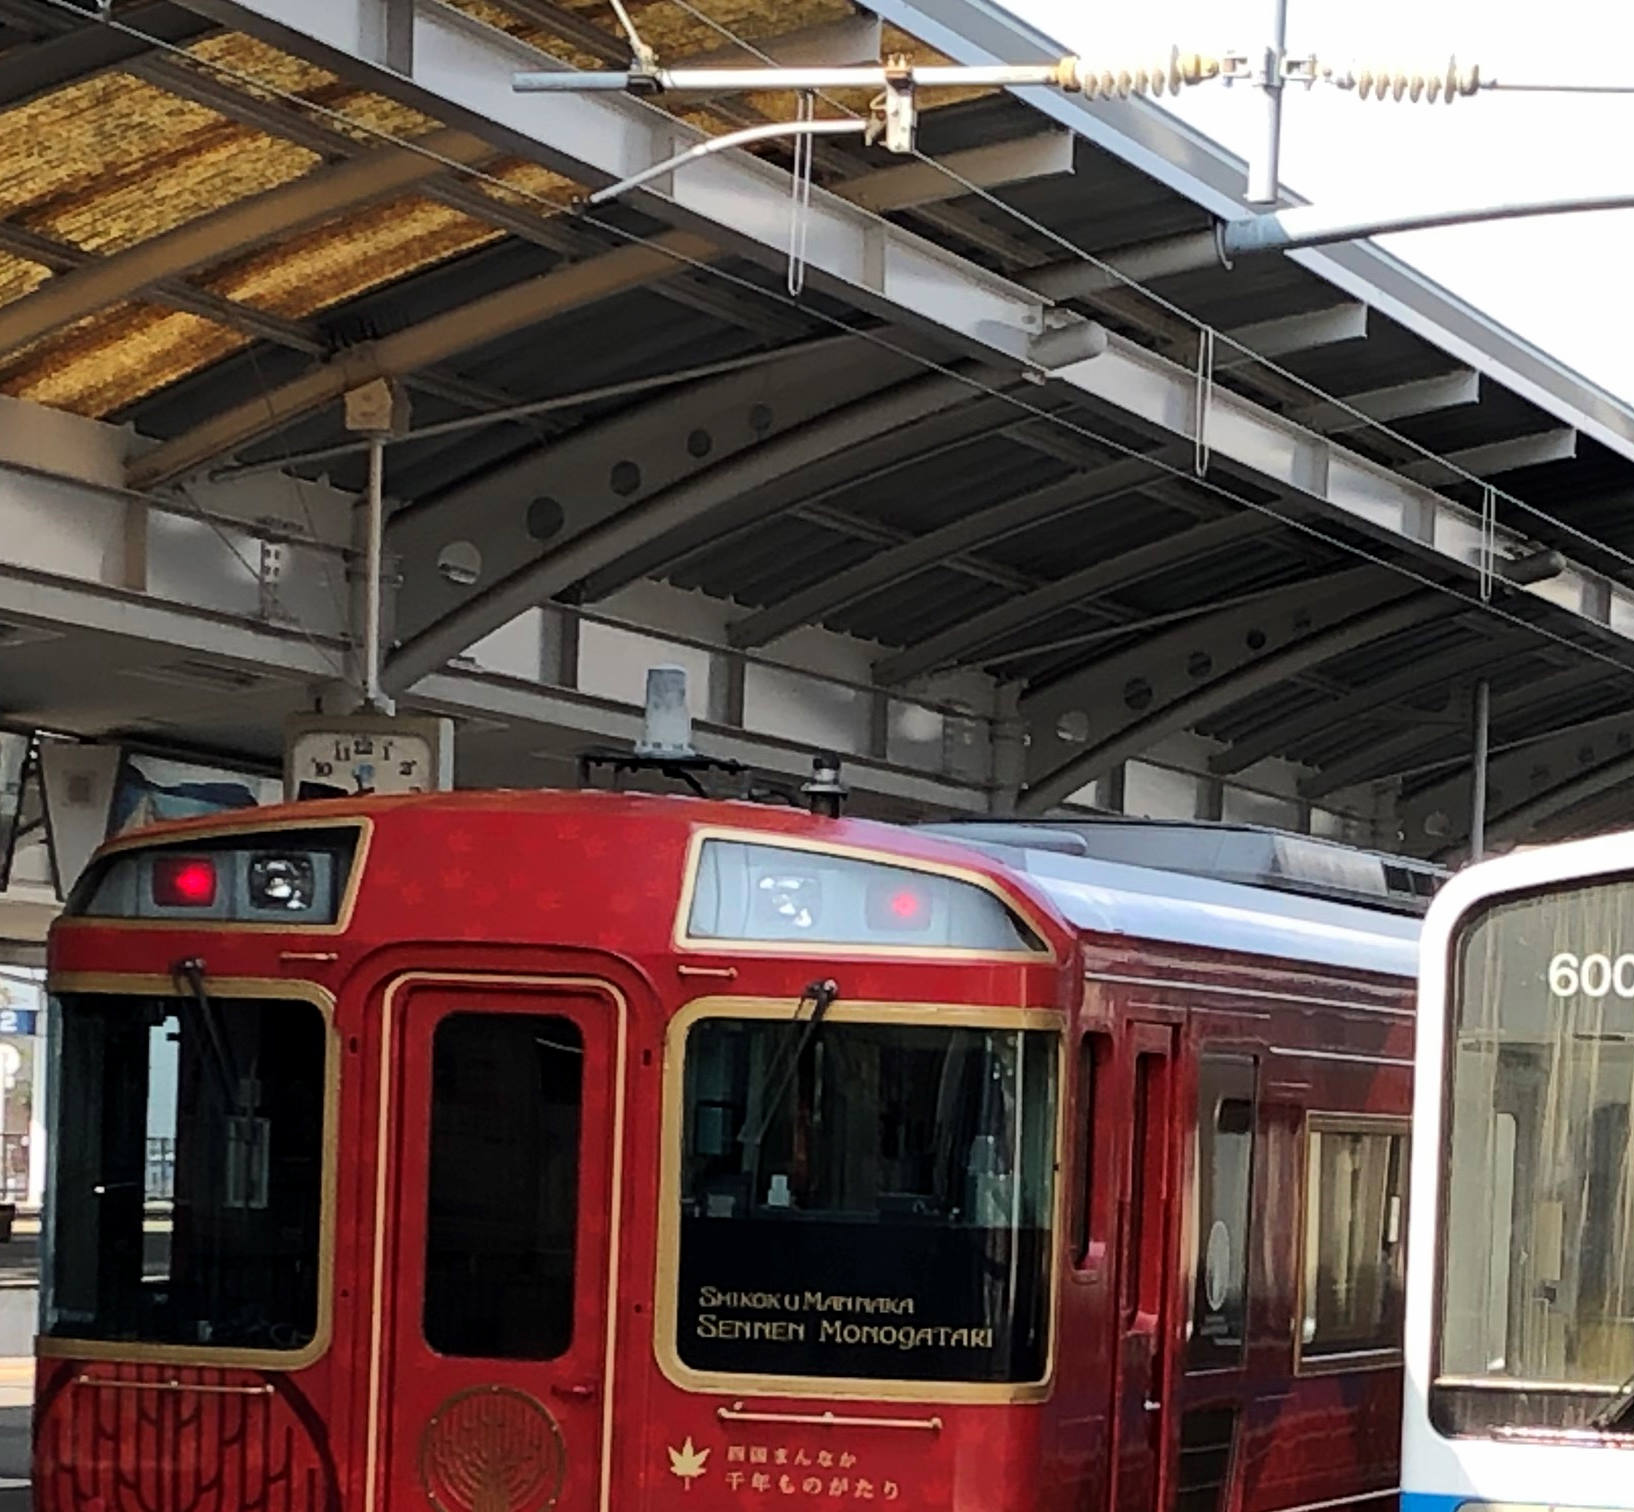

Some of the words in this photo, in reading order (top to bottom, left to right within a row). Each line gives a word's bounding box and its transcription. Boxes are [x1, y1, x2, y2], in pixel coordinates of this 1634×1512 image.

[727, 1446, 857, 1469] 四国まんなか
[725, 1471, 899, 1500] 千年ものがたり
